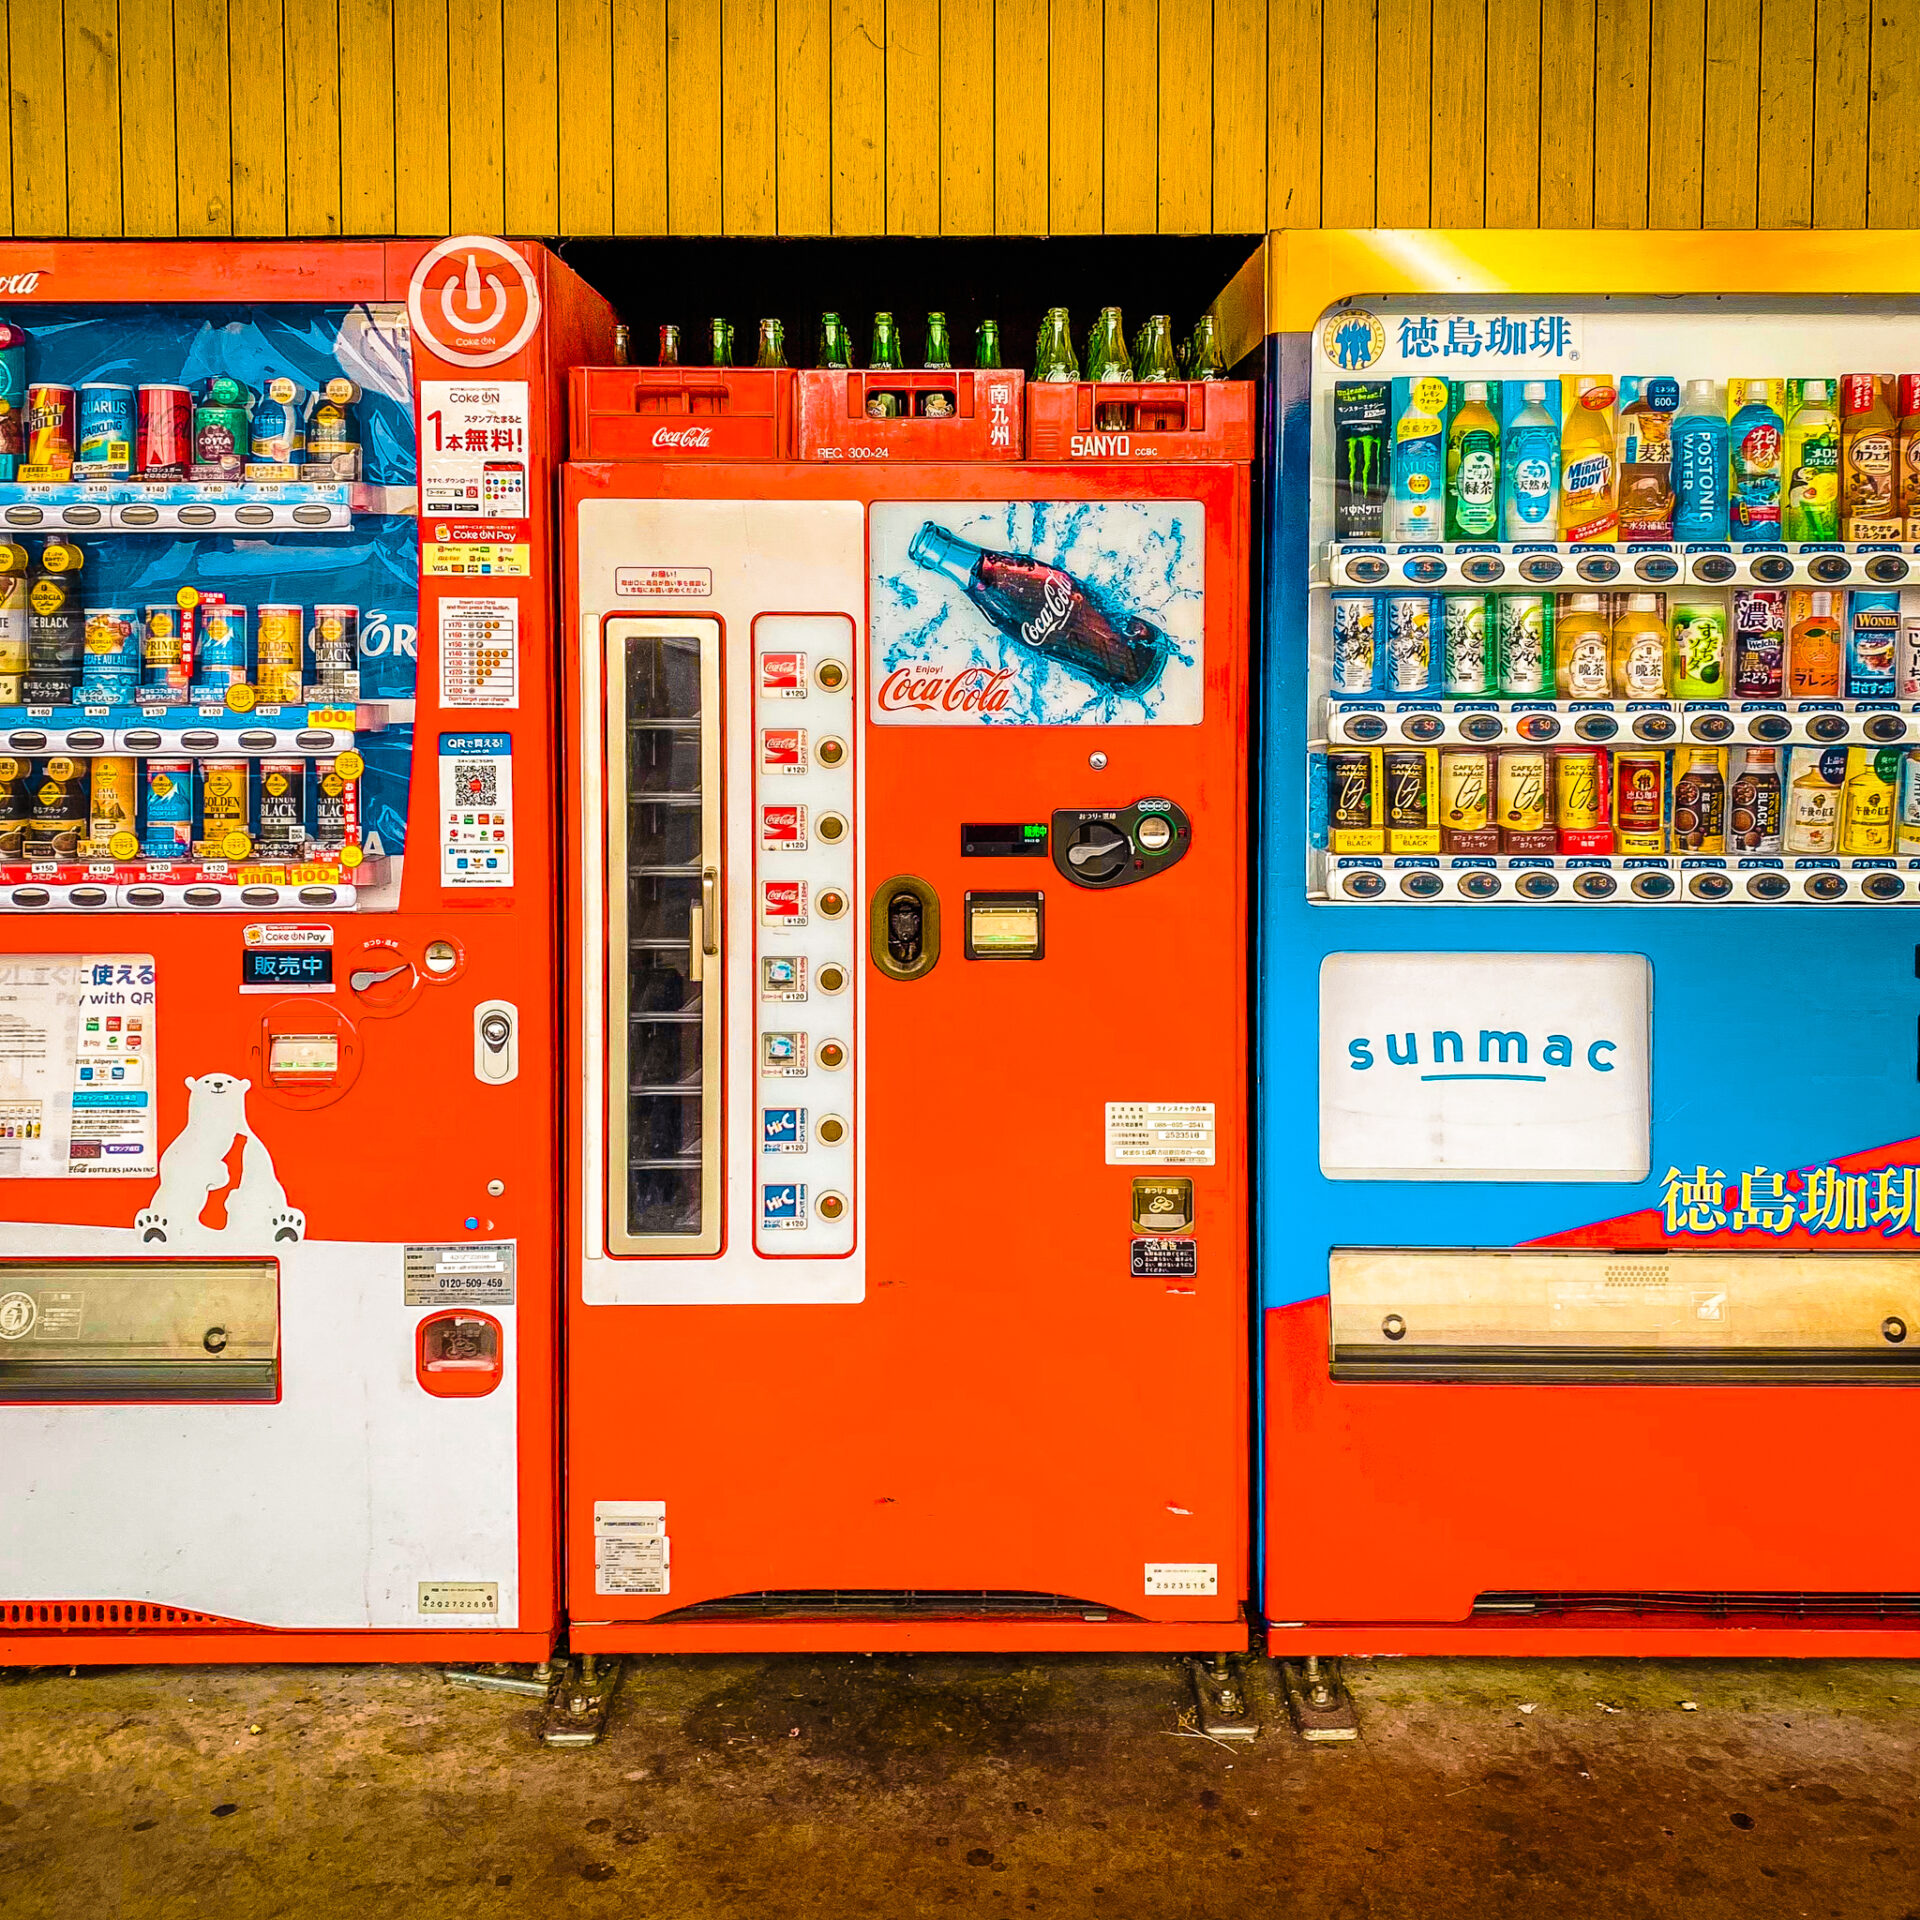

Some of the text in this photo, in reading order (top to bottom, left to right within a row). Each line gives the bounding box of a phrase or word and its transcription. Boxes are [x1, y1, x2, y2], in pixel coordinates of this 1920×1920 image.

[456, 337, 495, 346] Coke ON
[1397, 316, 1572, 358] 徳島珈琲
[450, 392, 500, 403] Coke ON
[30, 402, 66, 421] REAL
[1338, 402, 1385, 413] モンスターエナジー
[464, 415, 522, 423] スタンプたまると
[990, 384, 1010, 446] 南九州
[1402, 424, 1438, 433] 免疫ケア
[199, 437, 231, 446] COSTA
[652, 427, 713, 448] Coca-Cola
[1070, 435, 1130, 457] SANYO
[1639, 444, 1670, 462] 麦茶
[1683, 433, 1694, 490] WATER
[1567, 459, 1609, 479] MIRACLE
[1570, 475, 1600, 492] BODY
[1699, 432, 1714, 523] POSTONIC
[1465, 481, 1493, 495] 緑茶
[1519, 480, 1550, 492] 天然水
[453, 529, 516, 542] Coke ON Pay
[1021, 567, 1074, 646] Coca-Cola
[40, 617, 69, 628] BLACK
[1858, 614, 1897, 626] WONDA
[146, 640, 180, 650] PRIME
[182, 611, 193, 673] お手頃価格!
[1697, 624, 1718, 662] すだち
[1749, 640, 1777, 650] Welch's
[315, 649, 351, 662] BLACK
[1688, 639, 1701, 671] ソーダ
[764, 662, 796, 673] Coca-Cola
[915, 664, 944, 675] Enjoy!
[1578, 664, 1604, 676] 晩茶
[1635, 664, 1662, 676] 晩茶
[1739, 672, 1768, 685] ぶどう
[878, 666, 1016, 712] Coca-Cola
[448, 738, 503, 749] QRで買える!
[766, 738, 797, 749] Coca-Cola
[261, 804, 297, 817] BLACK
[345, 782, 356, 842] お手頃価格!
[1757, 792, 1768, 826] BLACK
[1800, 807, 1834, 817] 午後の紅茶
[1856, 806, 1889, 816] 午後の紅茶
[765, 814, 797, 825] Coca-Cola
[1024, 825, 1047, 837] 販売中
[363, 831, 386, 855] A
[767, 889, 797, 901] Coca-Cola
[265, 932, 326, 942] Coke ON Pay
[254, 956, 324, 977] 販売中
[91, 992, 154, 1005] with QR
[1348, 1029, 1617, 1072] sunmac
[440, 1279, 503, 1288] 0120-509-459
